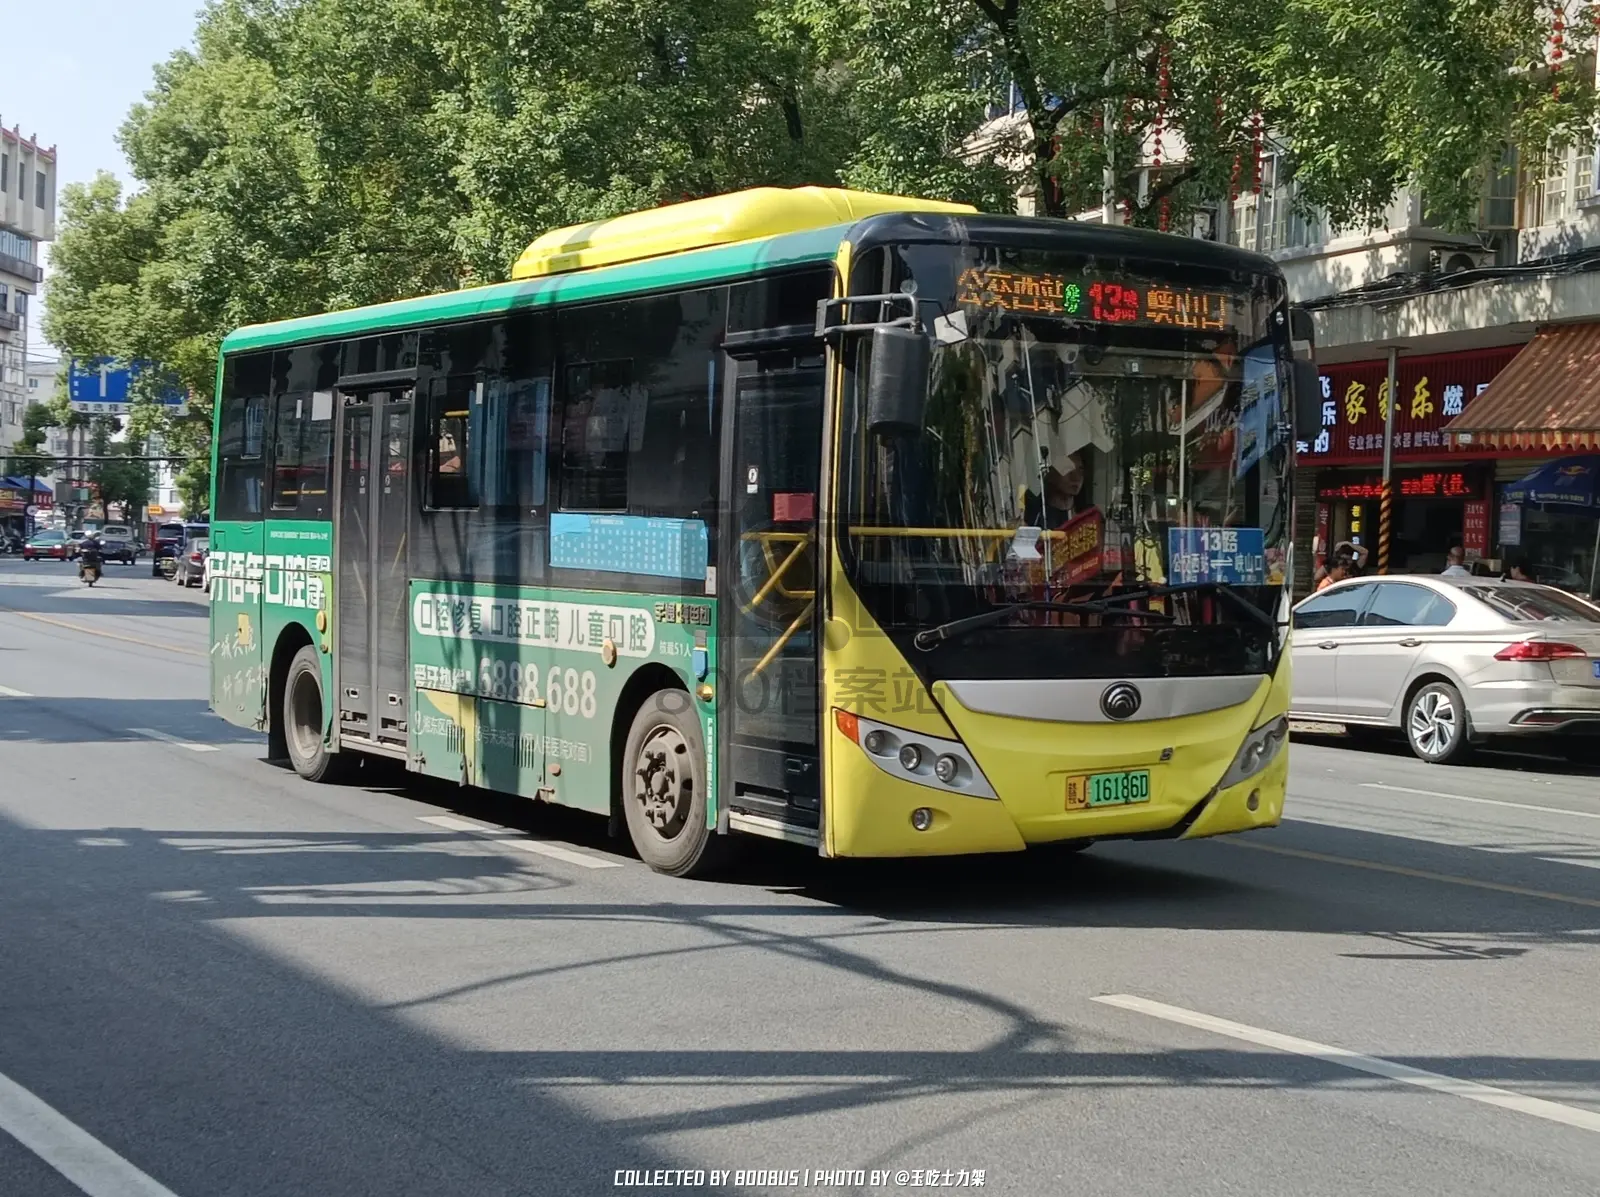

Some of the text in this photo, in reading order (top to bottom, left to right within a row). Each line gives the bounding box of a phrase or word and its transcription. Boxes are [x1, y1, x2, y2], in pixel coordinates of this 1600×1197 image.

[1200, 531, 1239, 553] 13路
[420, 599, 482, 636] 口腔修复
[490, 603, 559, 643] 口腔正畸
[568, 608, 648, 652] 儿童口腔
[1094, 774, 1148, 803] 16186D
